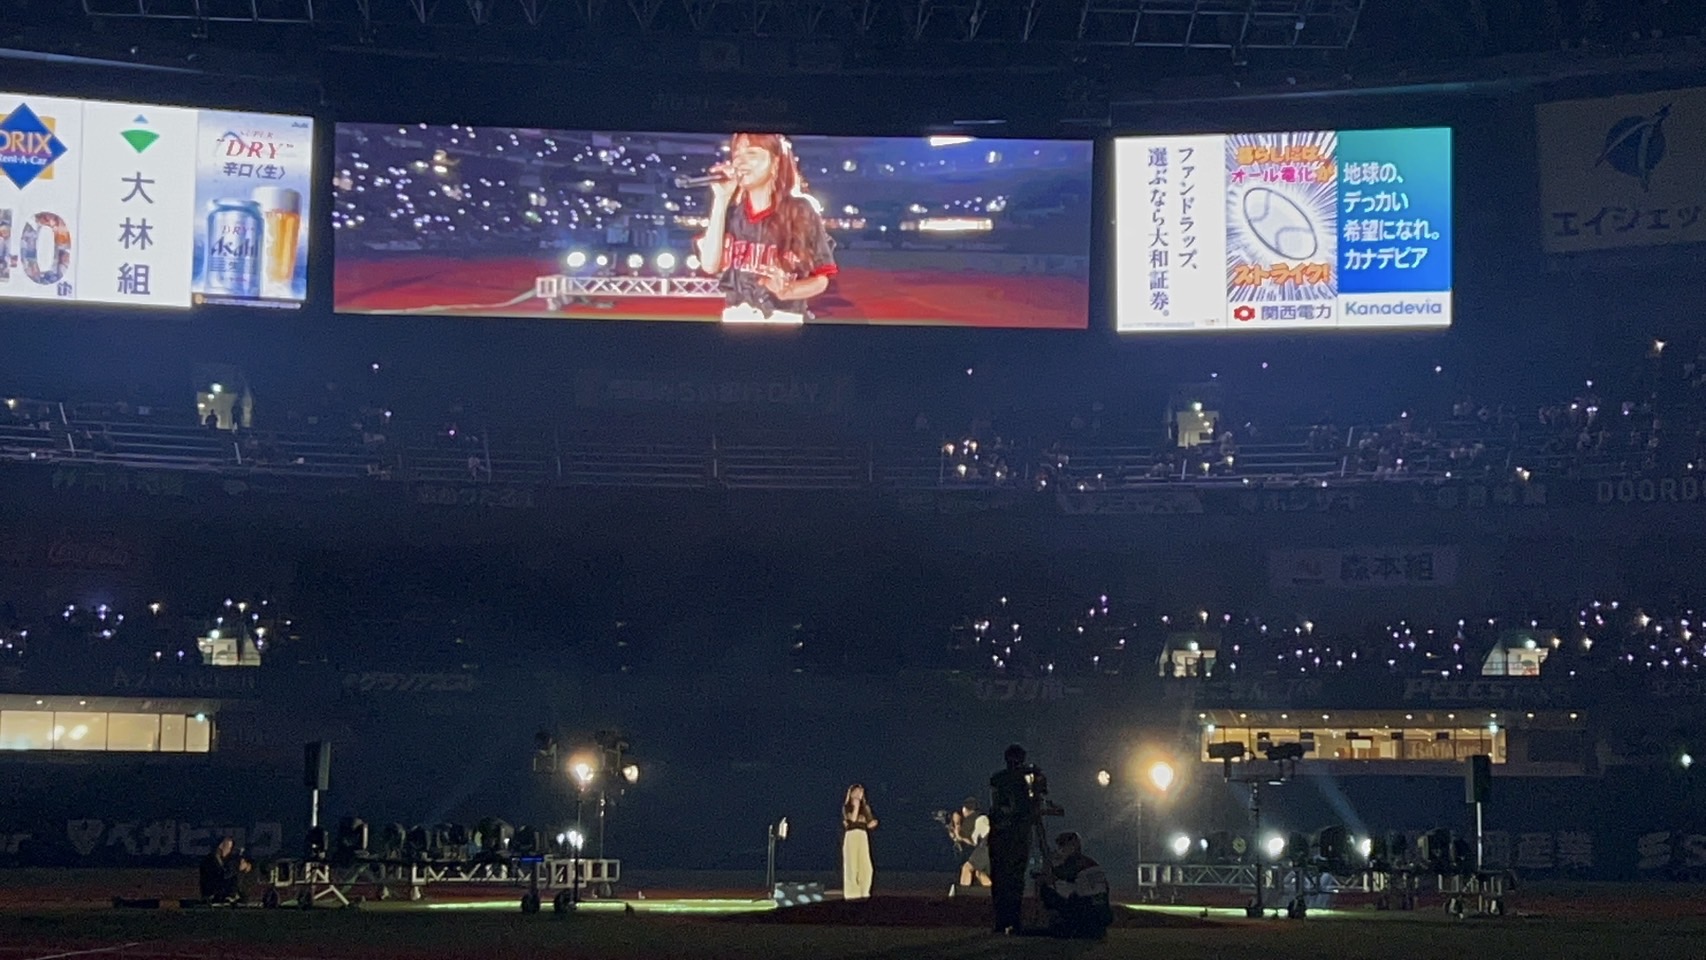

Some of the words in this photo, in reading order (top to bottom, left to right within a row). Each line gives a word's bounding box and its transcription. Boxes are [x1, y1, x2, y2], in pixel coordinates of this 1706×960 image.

[1342, 161, 1404, 185] 地球の、
[1178, 147, 1198, 270] ファンドラップ、
[117, 171, 155, 295] 大林組
[1148, 147, 1170, 317] 選ぶなら大和証券。
[1343, 218, 1440, 242] 希望になれ。
[1343, 246, 1428, 270] カナデビア
[1261, 304, 1332, 320] 関西電力
[1345, 299, 1442, 316] Kanadevia
